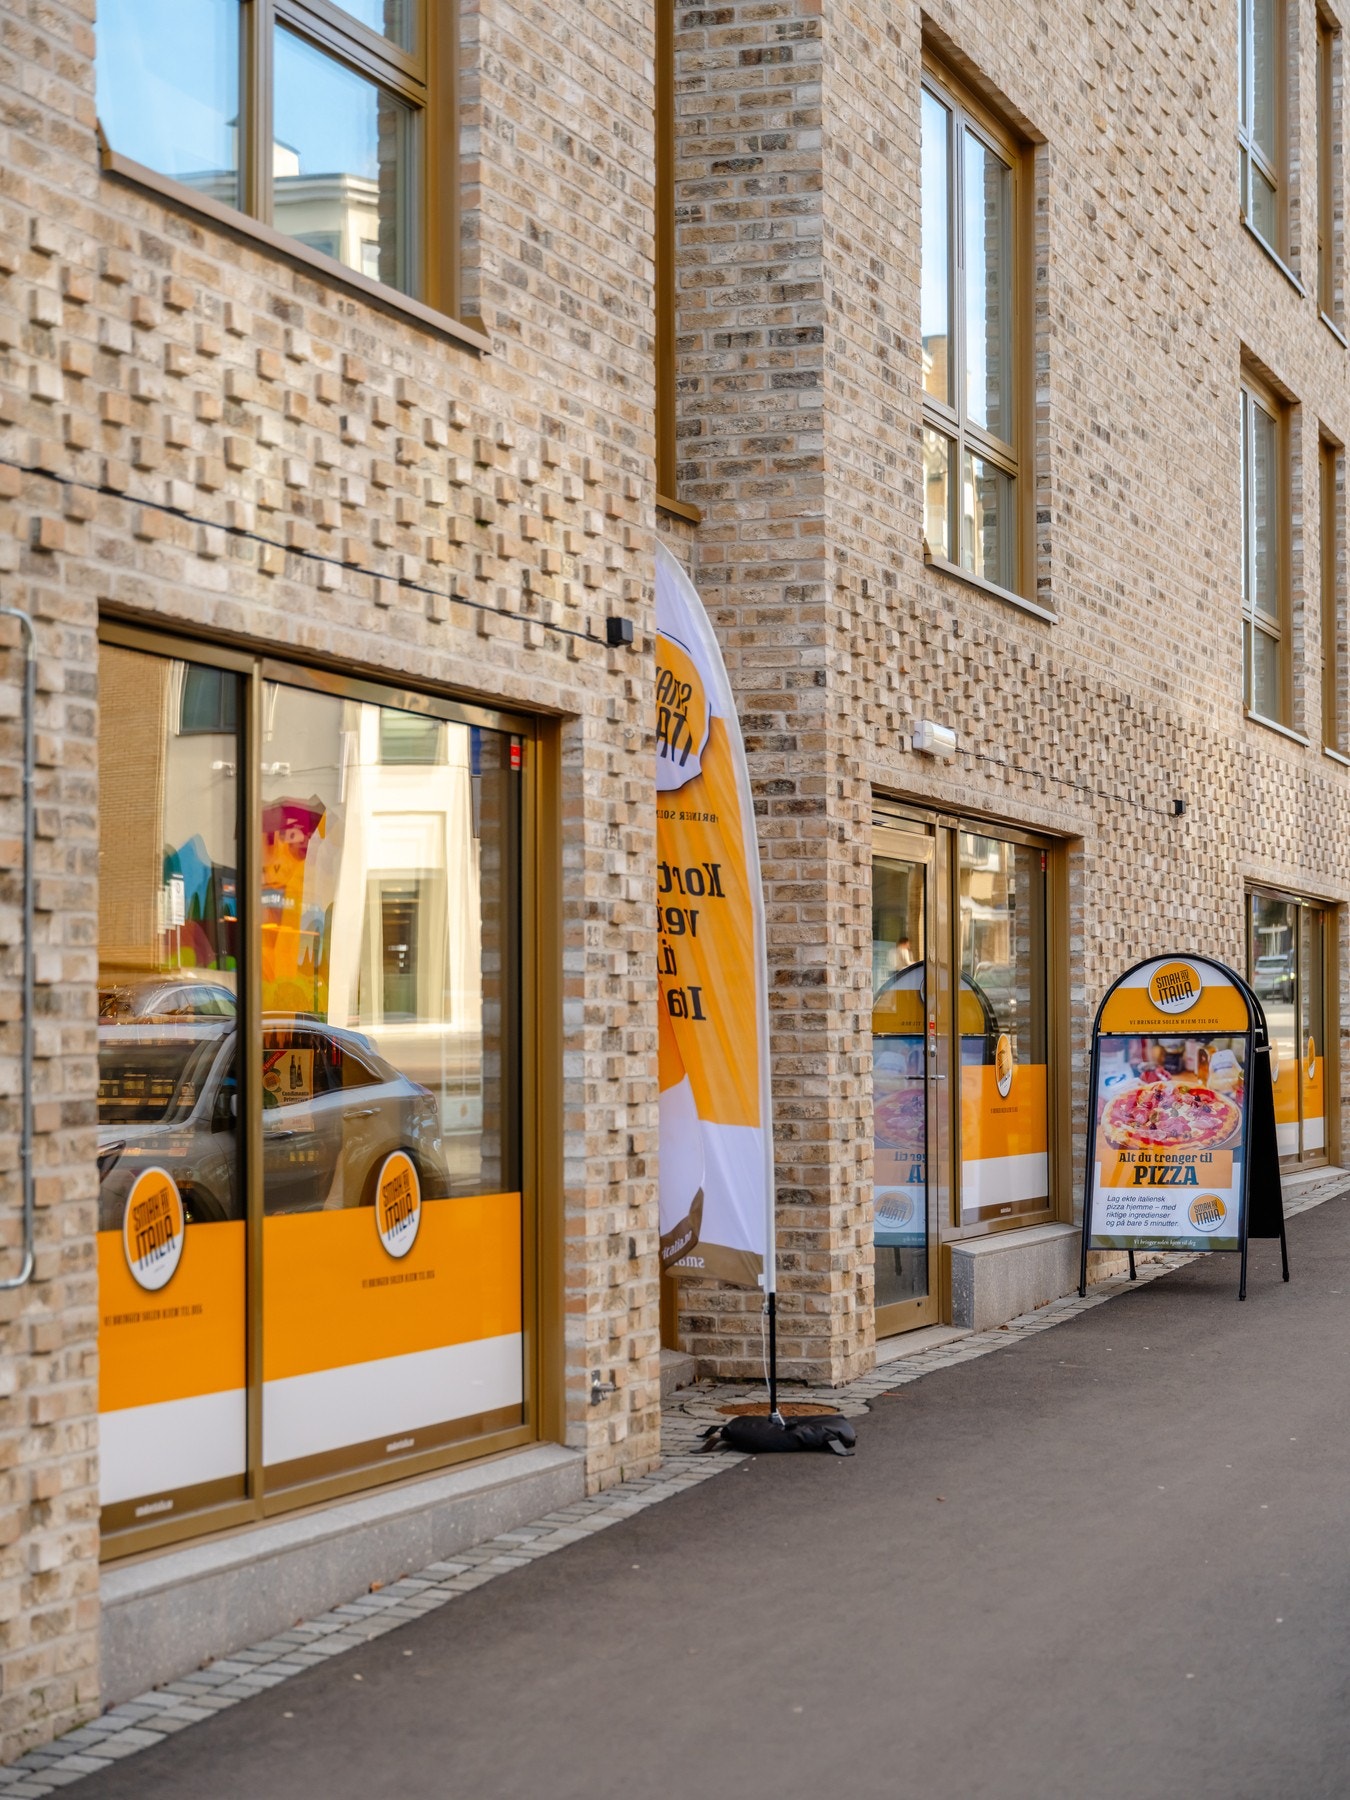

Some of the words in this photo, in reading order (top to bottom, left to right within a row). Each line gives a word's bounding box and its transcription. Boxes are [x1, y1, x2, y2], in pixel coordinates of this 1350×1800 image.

[1156, 972, 1181, 989] SMAK
[1158, 981, 1194, 1005] ITALIA
[1119, 1152, 1136, 1162] Alt
[1138, 1152, 1151, 1162] du
[1154, 1153, 1198, 1164] trenger
[1199, 1152, 1213, 1163] til
[1133, 1165, 1199, 1185] PIZZA
[1107, 1195, 1120, 1203] Lag
[1126, 1203, 1153, 1211] hjemme
[1195, 1208, 1221, 1225] ITALIA
